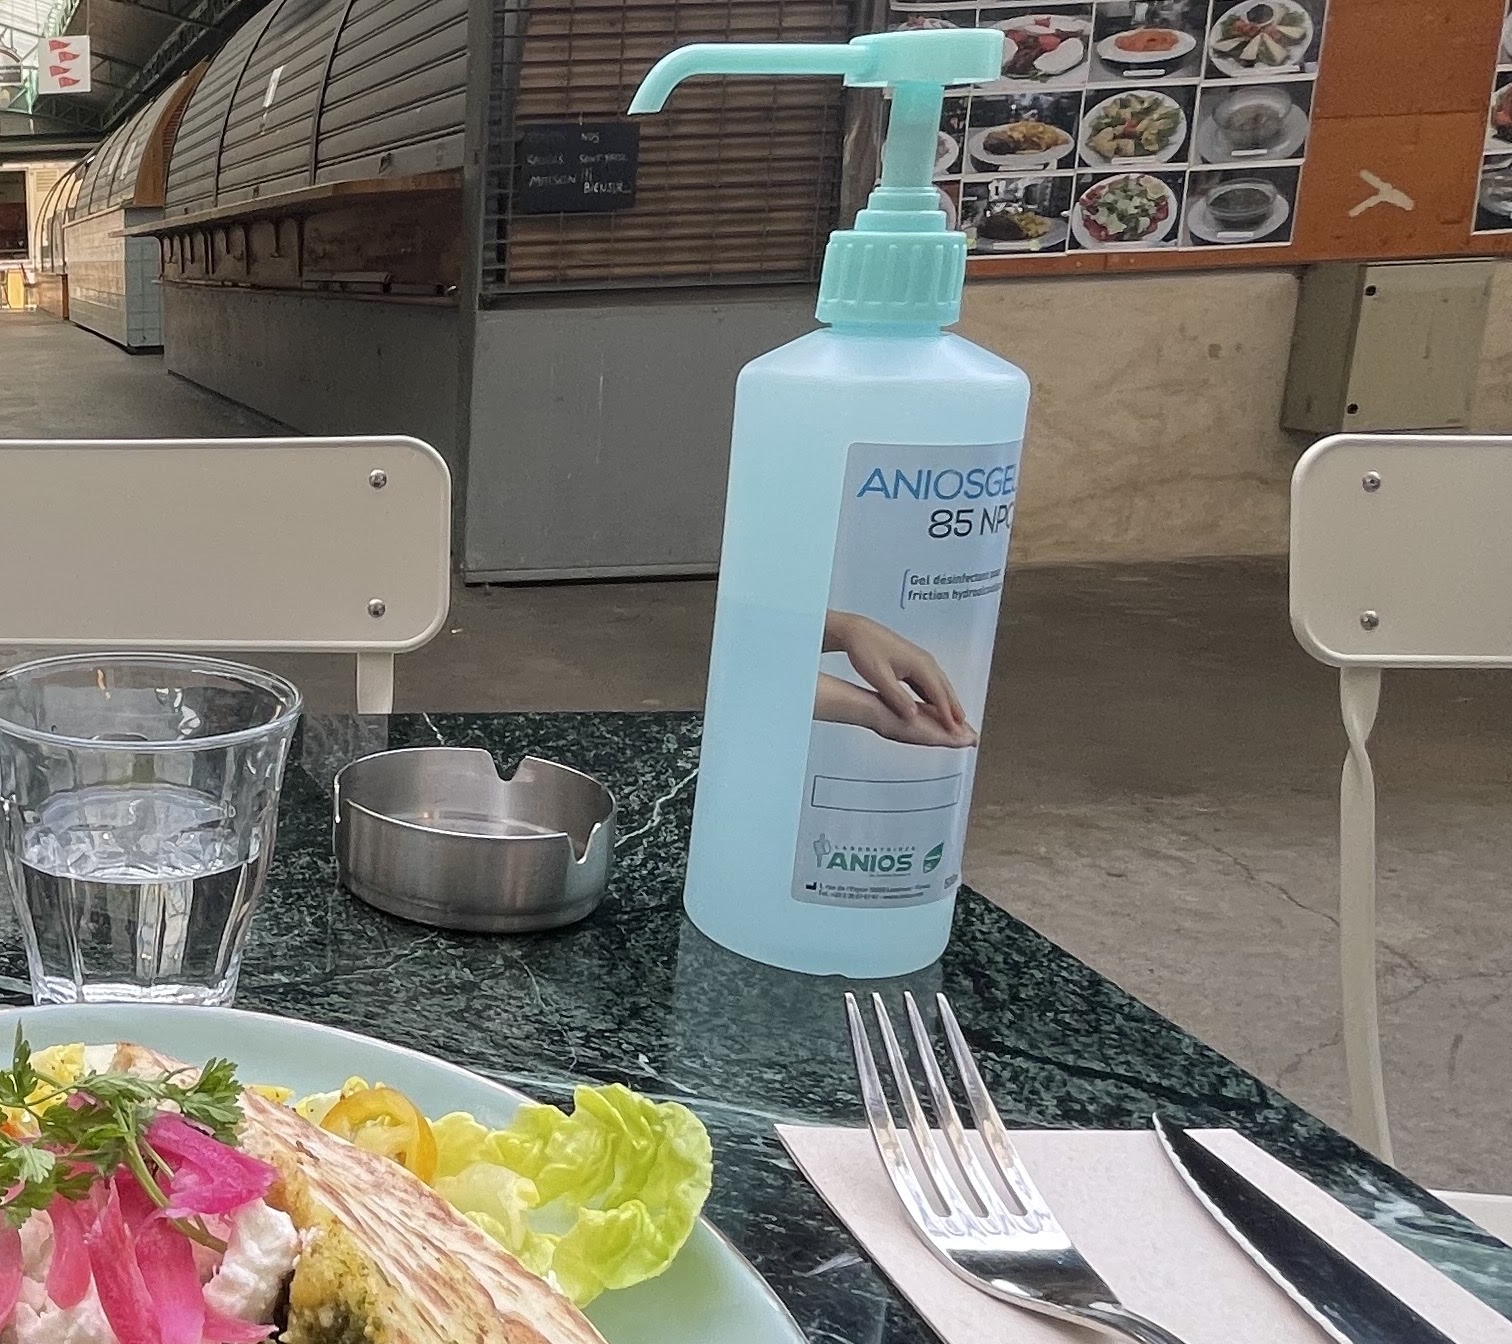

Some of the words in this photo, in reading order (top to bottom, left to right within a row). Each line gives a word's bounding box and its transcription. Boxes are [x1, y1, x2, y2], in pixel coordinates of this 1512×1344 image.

[928, 508, 974, 539] 85
[910, 573, 930, 585] Gel
[907, 589, 949, 601] friction
[826, 851, 914, 873] ANIOS
